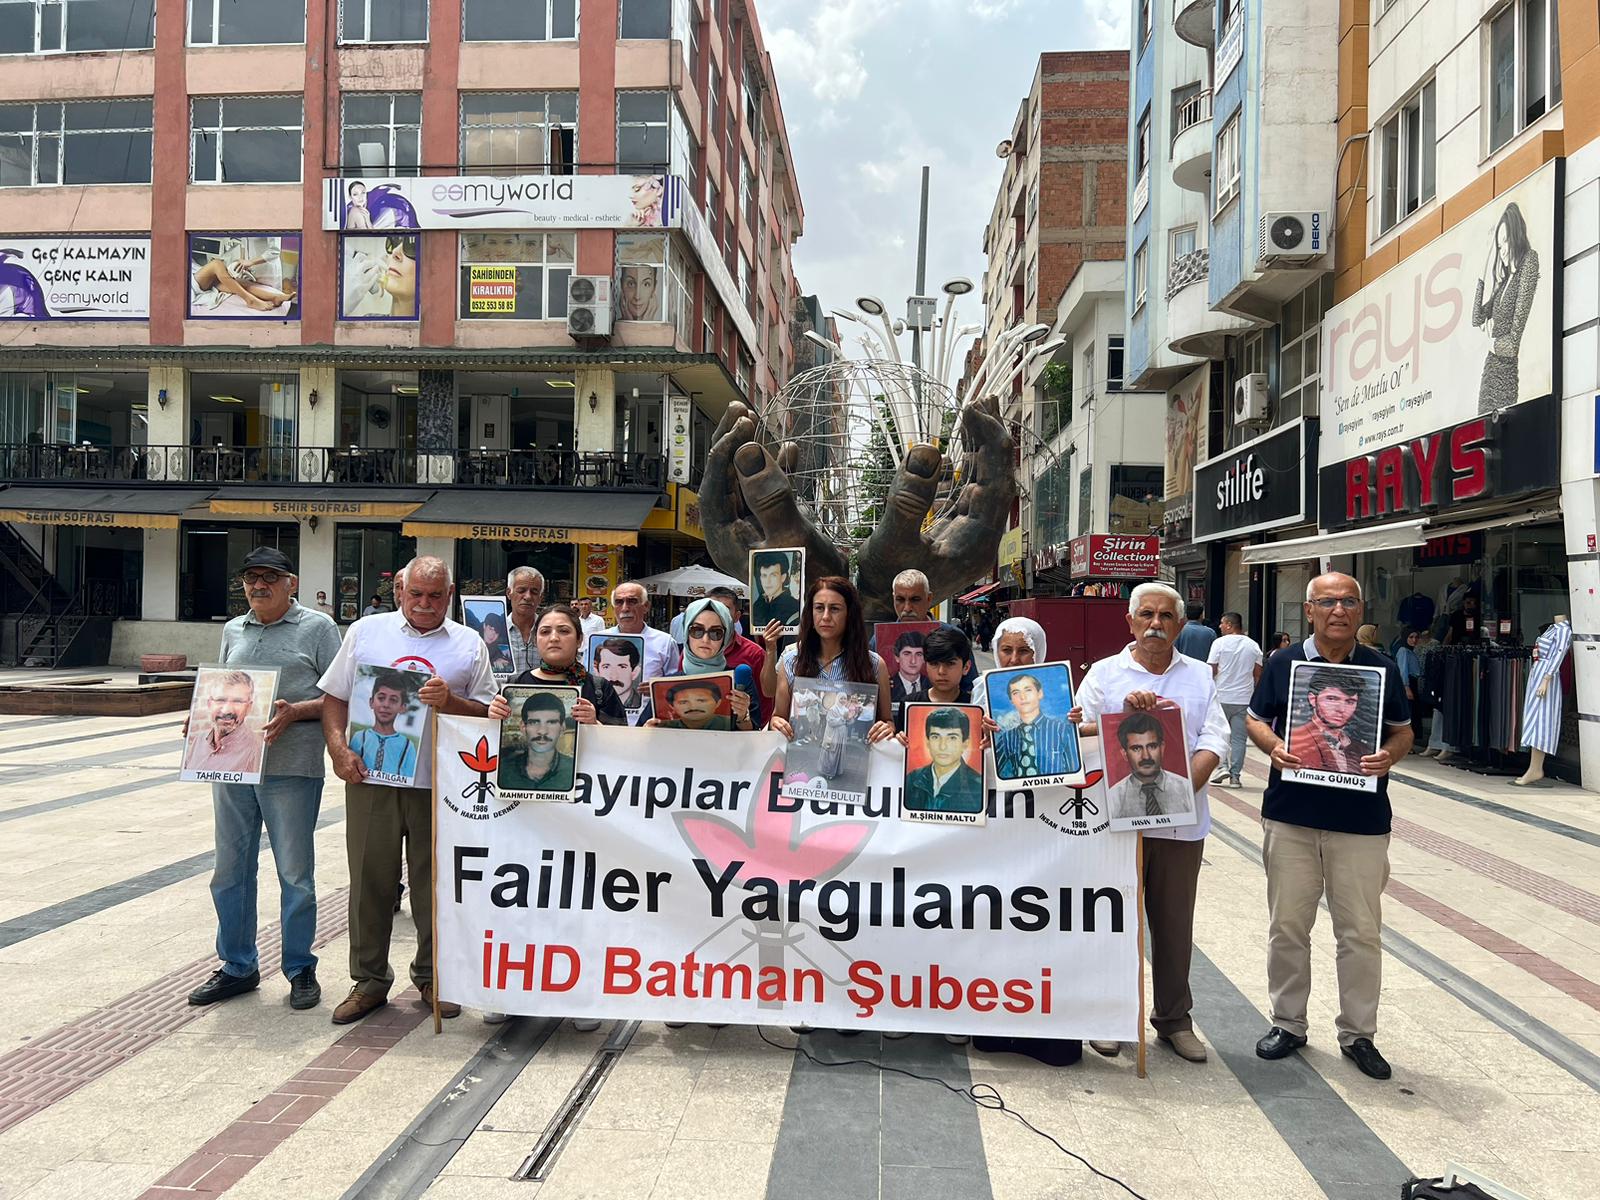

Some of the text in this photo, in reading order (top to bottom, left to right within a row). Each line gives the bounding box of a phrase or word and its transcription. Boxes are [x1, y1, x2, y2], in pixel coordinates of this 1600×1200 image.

[431, 178, 573, 206] esmyworld
[533, 213, 622, 223] beauty medical esthetic
[1311, 213, 1320, 250] BEKO
[63, 247, 146, 260] KALMAYIN
[85, 269, 132, 282] KALIN
[471, 267, 515, 280] SAHİBİNDEN
[50, 291, 129, 306] esmyworld
[1328, 252, 1464, 393] rays
[1350, 386, 1360, 407] de
[1361, 373, 1388, 403] Mutlu
[1346, 418, 1490, 520] RAYS
[1216, 453, 1263, 510] stilife
[310, 502, 361, 513] SOFRASI
[64, 512, 115, 523] SOFRASI
[513, 528, 569, 540] SOFRASI
[1102, 537, 1146, 552] Şirin
[1093, 551, 1154, 562] Collection
[196, 770, 243, 782] TAHİR ELÇİ
[375, 769, 408, 784] ATILGAN
[1022, 776, 1065, 787] AYDIN AY
[1292, 770, 1366, 788] Yılmaz GÜMÜŞ
[499, 791, 570, 801] MAHMUT DEMİREL
[573, 768, 751, 819] ayıplar
[788, 787, 862, 803] MERYEM BULUT
[460, 809, 490, 821] HAKLARI
[472, 804, 489, 813] 1986
[909, 811, 977, 823] M.ŞİRİN MALTU
[1038, 812, 1058, 830] İNSAN
[1060, 826, 1090, 837] HAKLARI
[1071, 820, 1087, 829] 1986
[453, 846, 673, 913] Failler
[692, 858, 1124, 942] Yargılansın
[482, 930, 1052, 1018] İHD Batman Şubesi
